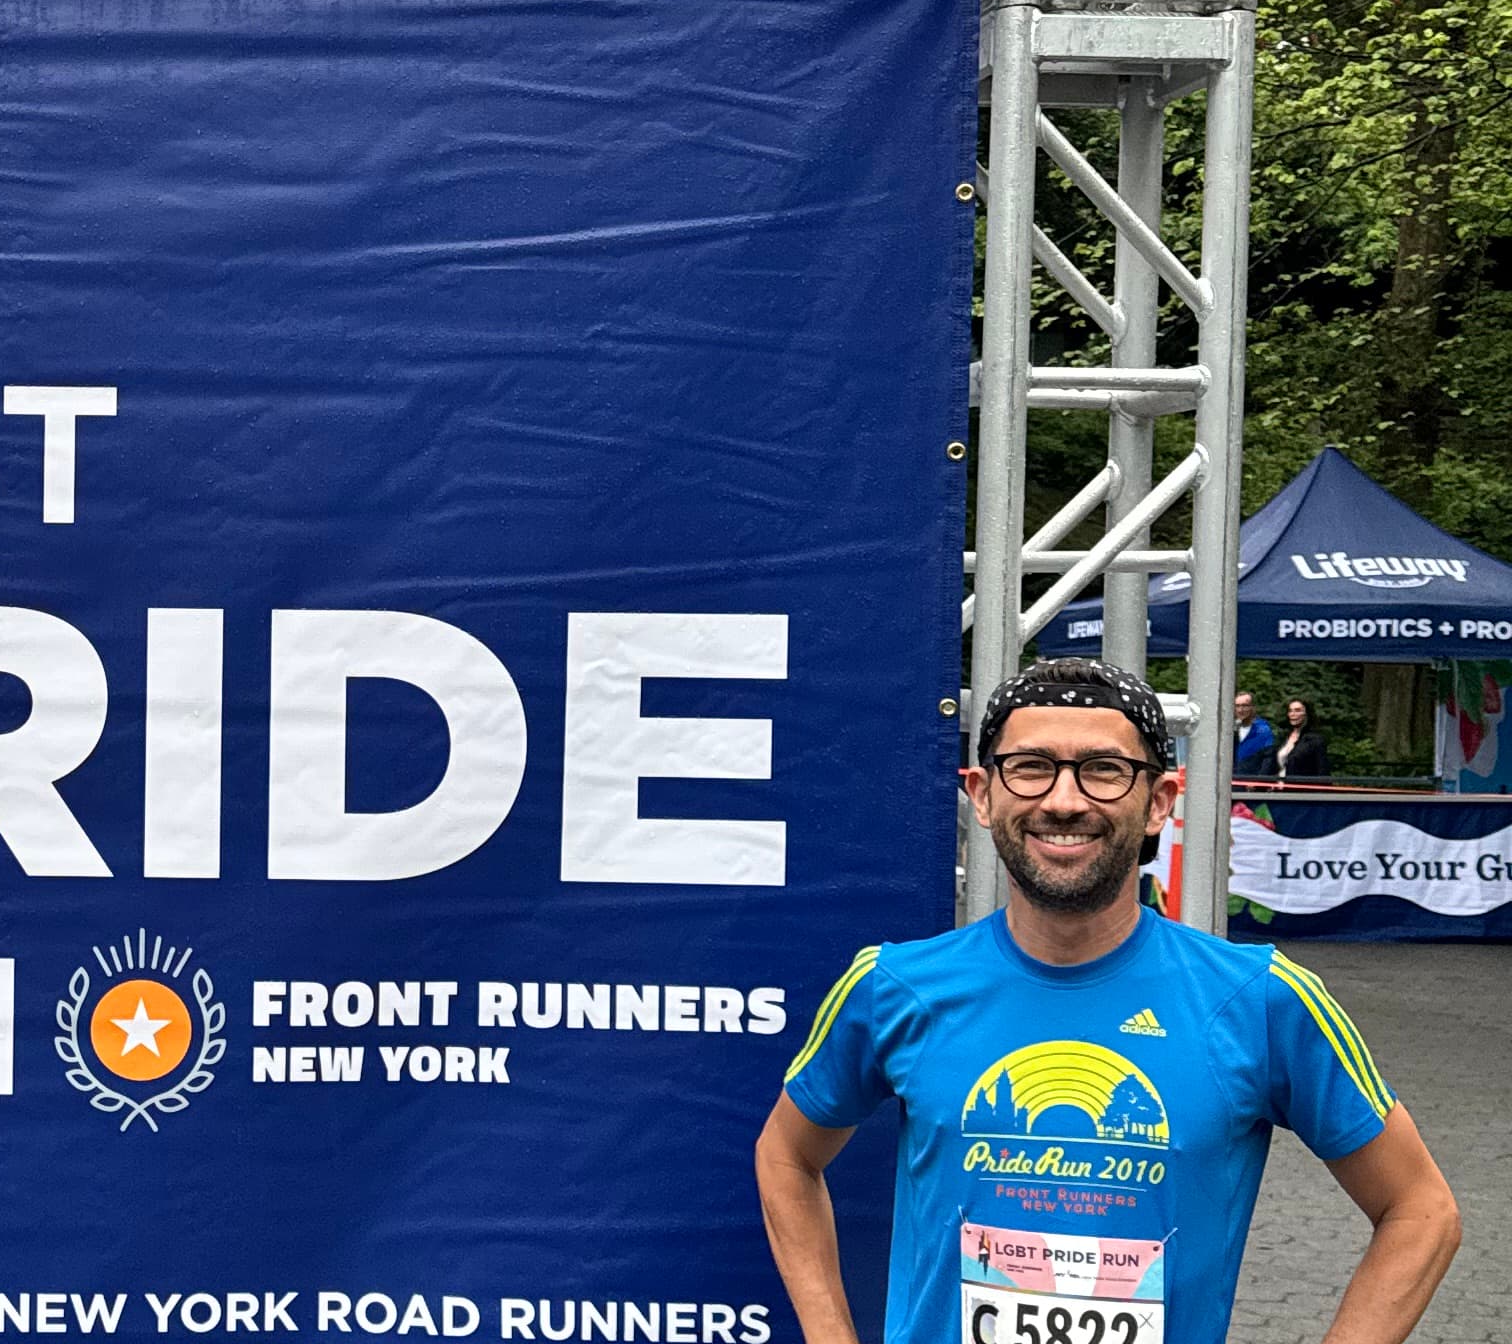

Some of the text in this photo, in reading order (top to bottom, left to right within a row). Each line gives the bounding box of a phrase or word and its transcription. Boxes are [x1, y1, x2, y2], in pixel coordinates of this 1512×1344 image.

[1291, 552, 1467, 582] Lifeway
[1278, 619, 1433, 638] PROBIOTICS
[1276, 852, 1367, 880] Love
[1375, 853, 1465, 881] Your
[252, 981, 787, 1035] FRONT RUNNERS
[1120, 1024, 1167, 1037] adidas
[252, 1045, 510, 1084] NEW YORK
[1098, 1155, 1165, 1184] 2010
[996, 1184, 1137, 1207] FRONT RUNNERS
[1022, 1200, 1108, 1216] NEW YORK
[995, 1242, 1140, 1268] LGBT PRIDE RUN
[145, 1292, 298, 1333] YORK
[318, 1291, 480, 1337] ROAD
[501, 1298, 771, 1344] RUNNERS
